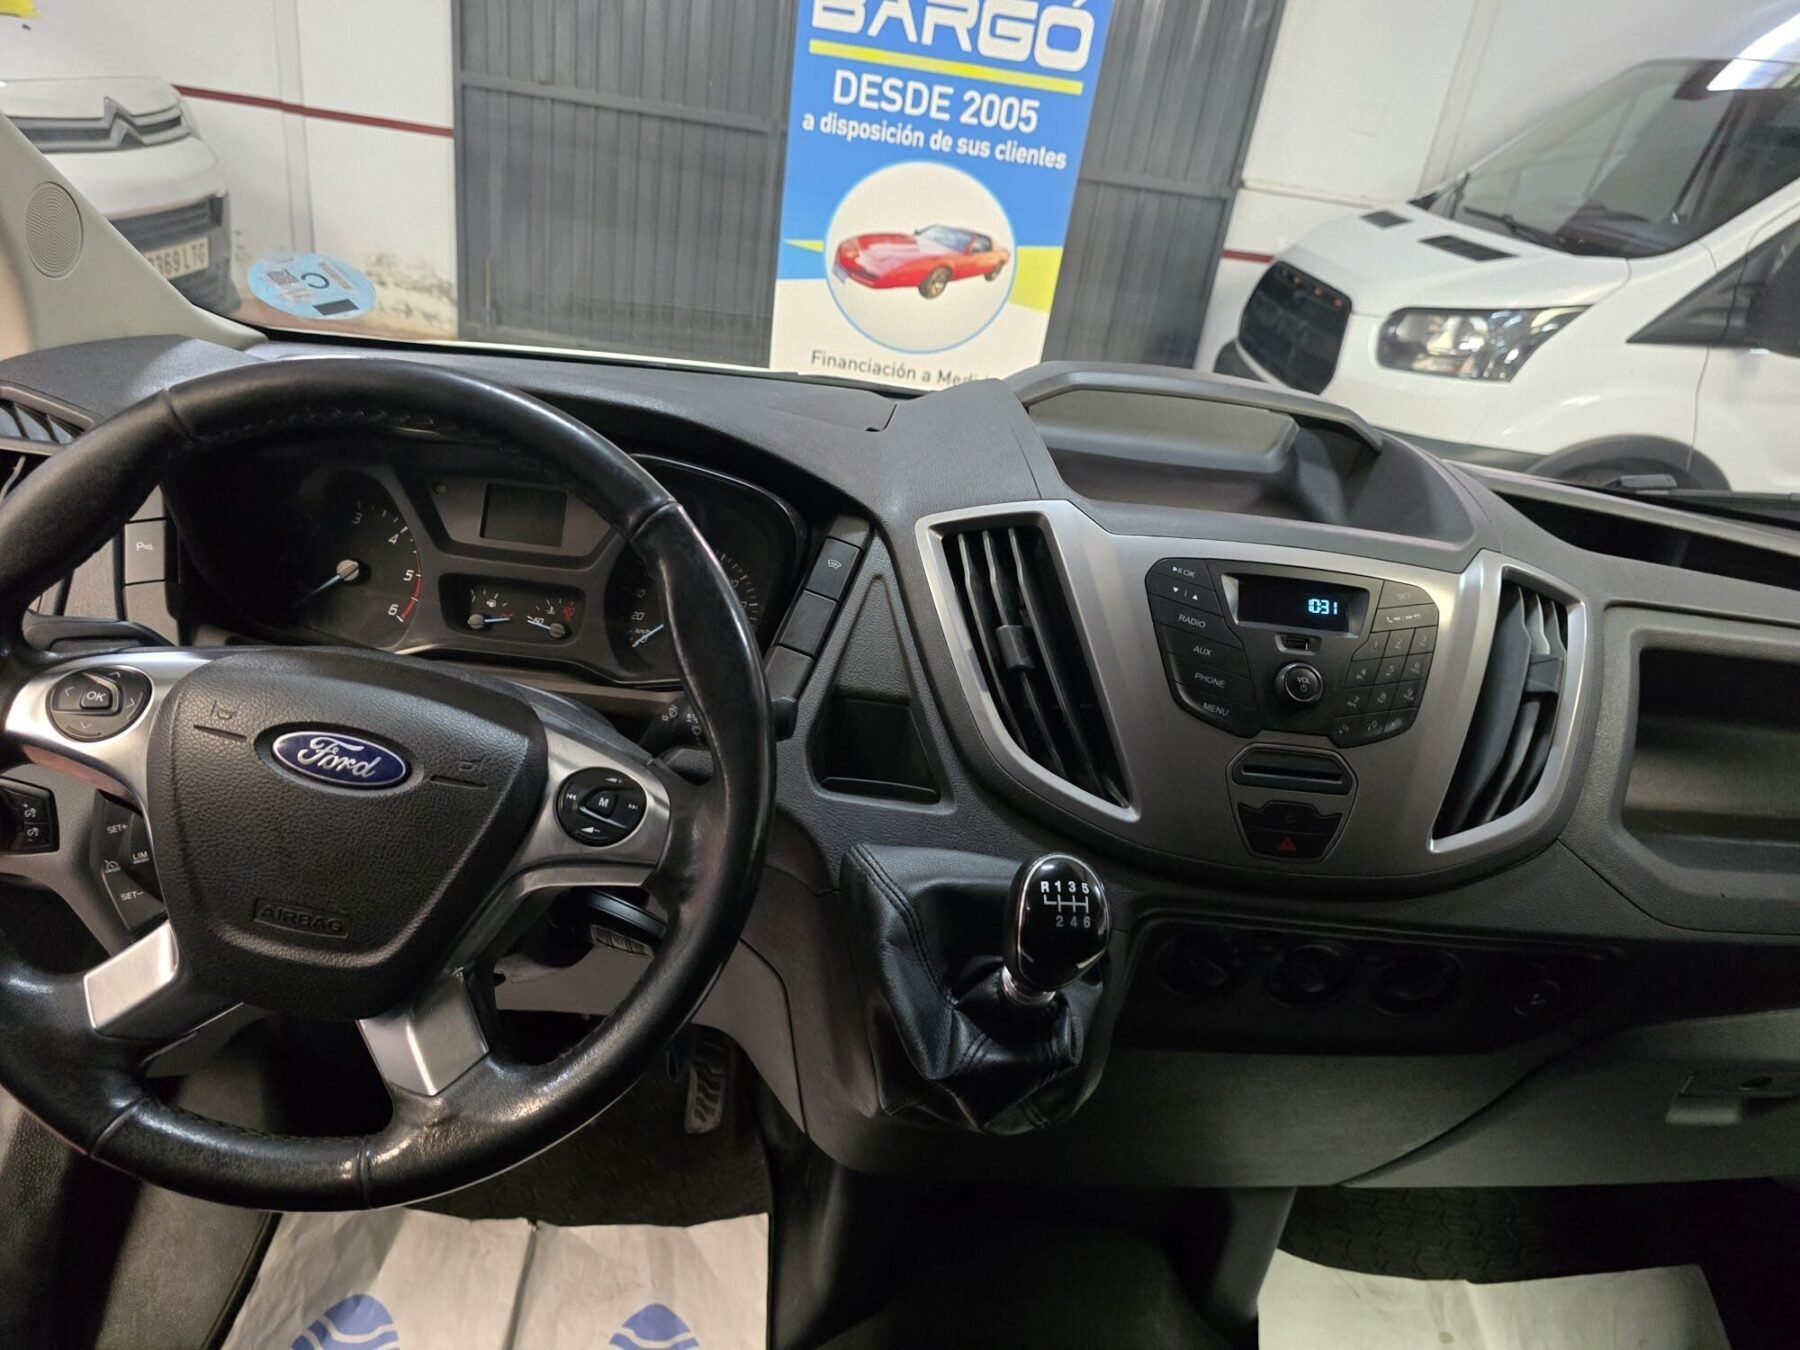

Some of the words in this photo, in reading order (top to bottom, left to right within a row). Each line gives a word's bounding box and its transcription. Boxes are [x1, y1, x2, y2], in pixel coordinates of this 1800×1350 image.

[811, 0, 1095, 73] BARGÓ
[833, 69, 954, 121] DESDE
[959, 90, 1040, 133] 2005
[802, 113, 815, 131] a
[819, 112, 925, 149] disposición
[929, 129, 953, 153] de
[956, 138, 991, 158] sus
[994, 139, 1067, 170] clientes
[811, 350, 916, 380] Financiación
[921, 371, 931, 383] a
[388, 533, 399, 545] 4
[403, 570, 414, 581] 5
[388, 604, 398, 616] 6
[631, 611, 645, 621] 20
[1179, 614, 1206, 629] RADIO
[1193, 645, 1212, 657] AUX
[1195, 671, 1226, 689] PHONE
[86, 690, 104, 702] OK
[1202, 702, 1230, 717] MENU
[297, 736, 382, 778] Ford
[598, 797, 609, 808] M
[132, 851, 148, 860] LIM
[1041, 881, 1049, 893] R
[1055, 880, 1061, 892] 1
[1068, 881, 1077, 893] 3
[1081, 882, 1089, 894] 5
[259, 904, 342, 933] AIRBAG
[1056, 915, 1063, 927] 2
[1070, 915, 1077, 927] 4
[1083, 916, 1091, 928] 6
